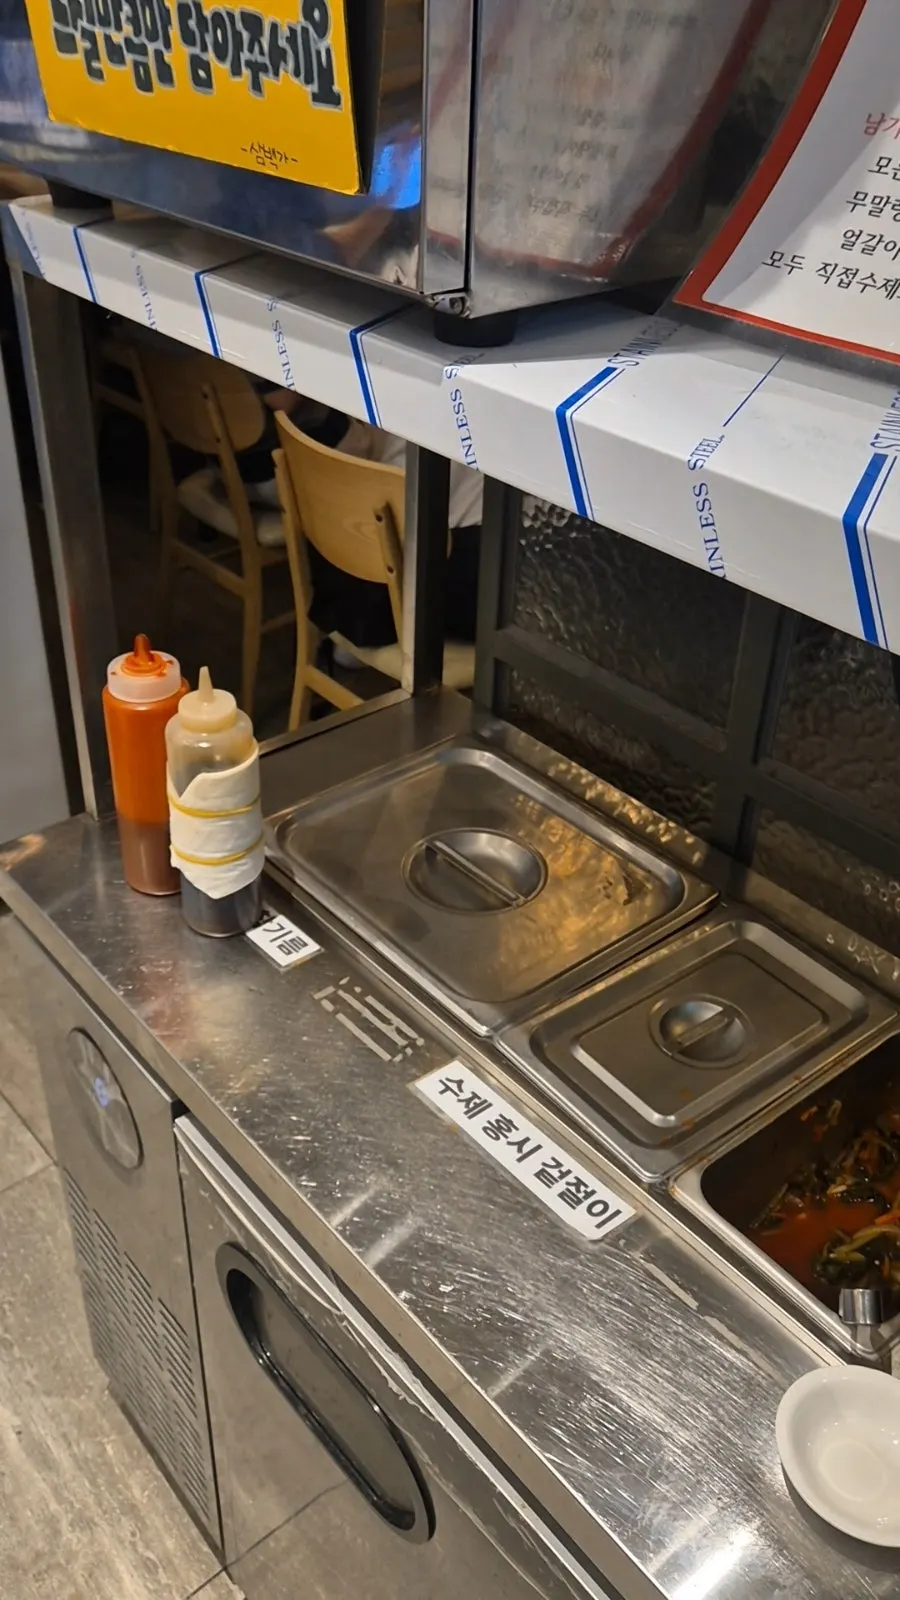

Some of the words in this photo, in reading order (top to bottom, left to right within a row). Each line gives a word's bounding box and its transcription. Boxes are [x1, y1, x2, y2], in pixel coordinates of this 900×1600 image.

[176, 0, 343, 107] 담아주세요
[761, 250, 805, 275] 모두
[815, 262, 900, 300] 직접수제
[271, 319, 296, 392] INLESS
[450, 388, 479, 471] INLESS
[688, 434, 725, 471] STEEL
[693, 482, 727, 579] INLESS
[262, 922, 309, 956] 기름
[438, 1077, 494, 1120] 수제
[481, 1113, 543, 1164] 홍시
[533, 1156, 623, 1230] 겉절이
